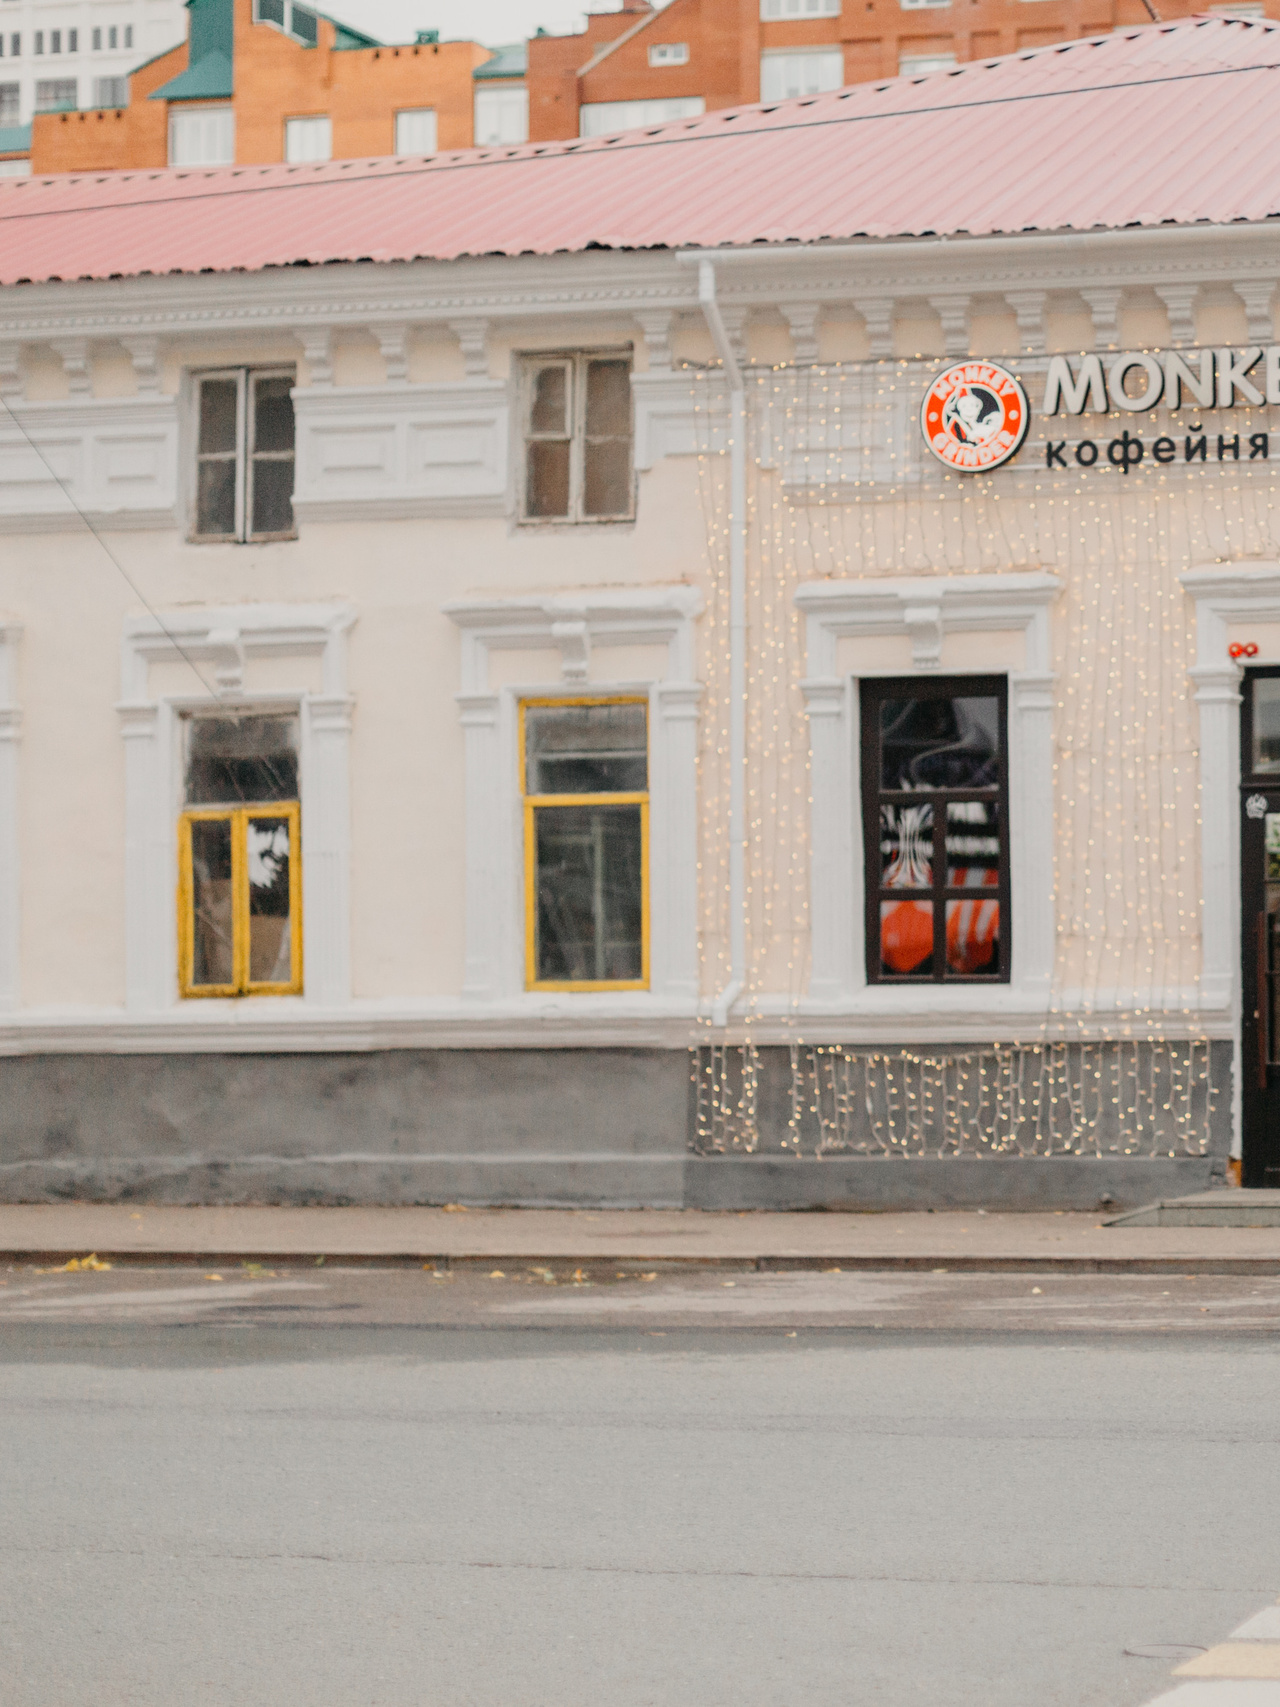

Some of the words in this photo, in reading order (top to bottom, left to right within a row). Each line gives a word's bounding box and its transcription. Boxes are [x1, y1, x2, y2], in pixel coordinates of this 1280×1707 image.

[933, 365, 1016, 400] MONKEY
[932, 430, 1016, 466] GRINDER
[1046, 424, 1269, 475] кофейня
